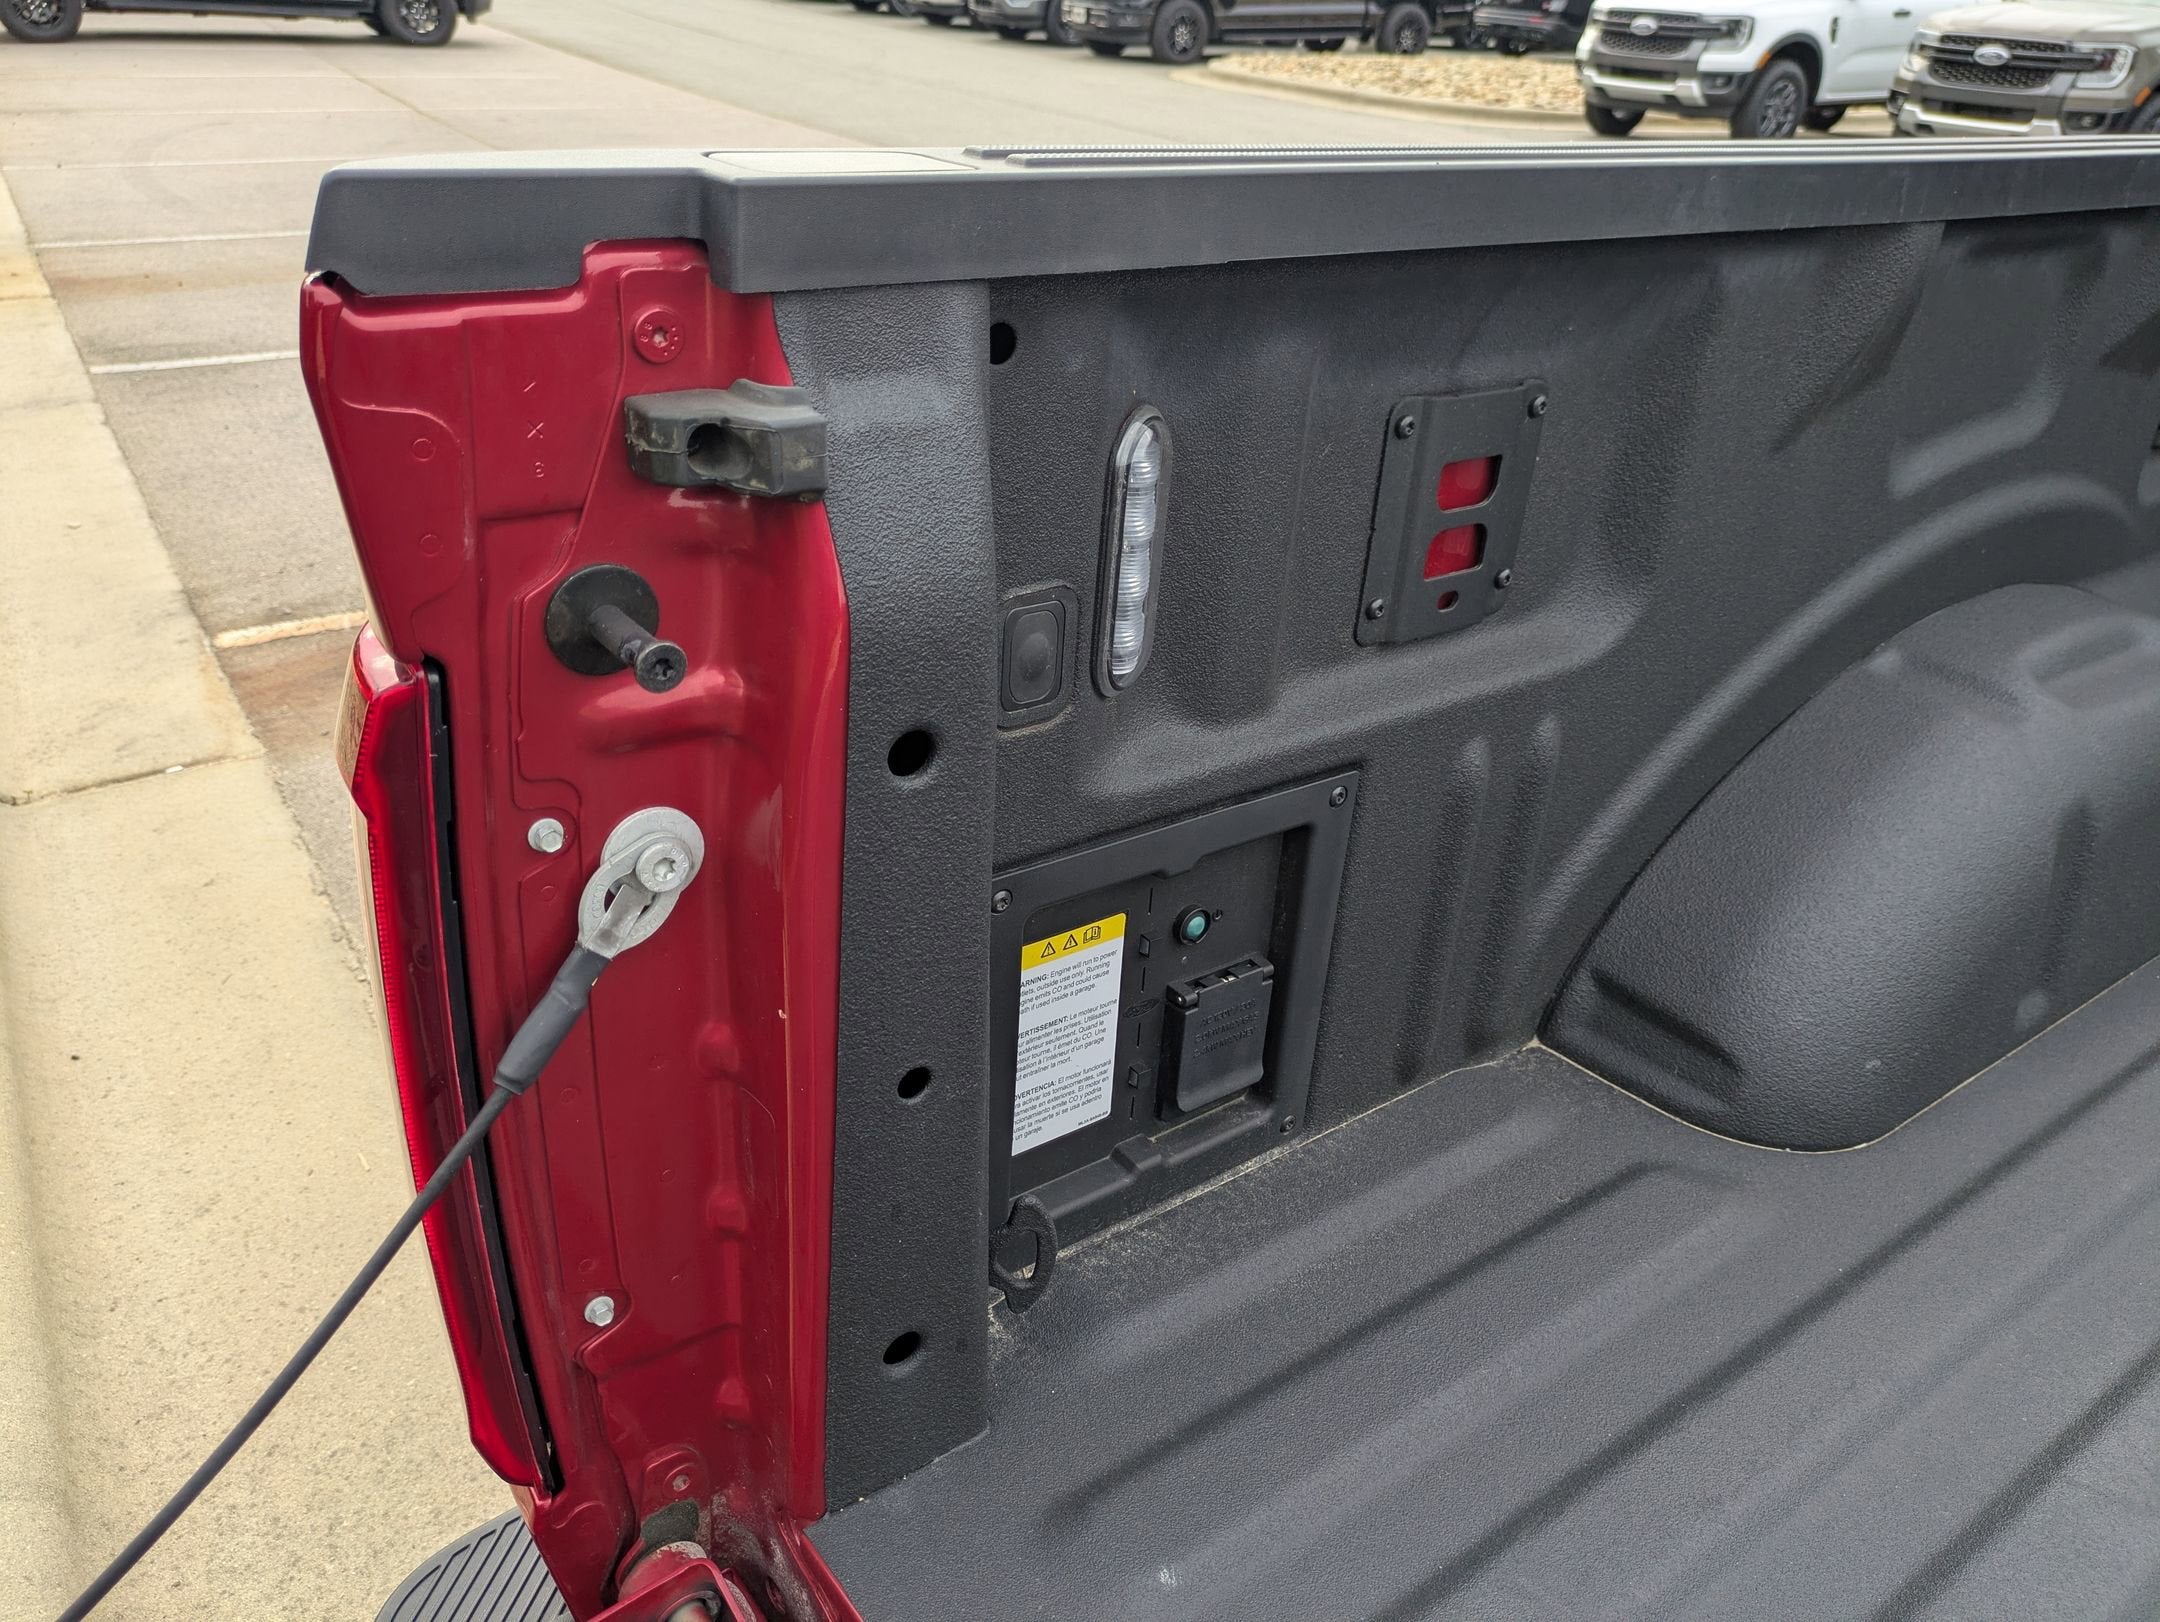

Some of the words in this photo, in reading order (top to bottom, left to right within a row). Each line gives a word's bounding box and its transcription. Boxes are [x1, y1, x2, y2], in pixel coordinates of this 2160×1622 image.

[1020, 974, 1049, 989] ARNING:
[1050, 966, 1071, 978] Engine
[1072, 961, 1081, 970] will
[1082, 958, 1092, 966] run
[1099, 949, 1117, 961] power
[1036, 979, 1058, 991] outside
[1059, 975, 1070, 983] use
[1086, 961, 1110, 973] Running
[1020, 997, 1034, 1007] gine
[1034, 990, 1051, 1000] emits
[1052, 985, 1062, 994] CO
[1063, 980, 1074, 990] and
[1075, 974, 1091, 986] could
[1092, 969, 1109, 980] cause
[1020, 1006, 1030, 1014] ath
[1035, 998, 1050, 1009] used
[1051, 992, 1068, 1003] inside
[1018, 1015, 1068, 1040] ERTISSEMENT:
[1078, 1005, 1098, 1016] moteur
[1099, 998, 1117, 1009] tourne
[1025, 1030, 1053, 1045] alimenter
[1084, 1009, 1111, 1023] Utilisation
[1078, 1021, 1098, 1033] Quand
[1057, 1039, 1072, 1049] émet
[1094, 1027, 1106, 1036] Une
[1084, 1036, 1104, 1049] garage
[1015, 1080, 1056, 1102] DVERTENCIA:
[1058, 1076, 1064, 1084] El
[1065, 1071, 1082, 1081] motor
[1022, 1094, 1041, 1106] activar
[1042, 1090, 1051, 1098] los
[1096, 1068, 1108, 1077] usar
[1084, 1079, 1101, 1089] motor
[1034, 1113, 1054, 1124] muerte
[1069, 1103, 1080, 1111] usa
[1081, 1094, 1102, 1106] adentro
[1051, 1100, 1067, 1110] emite
[1068, 1094, 1078, 1103] CO
